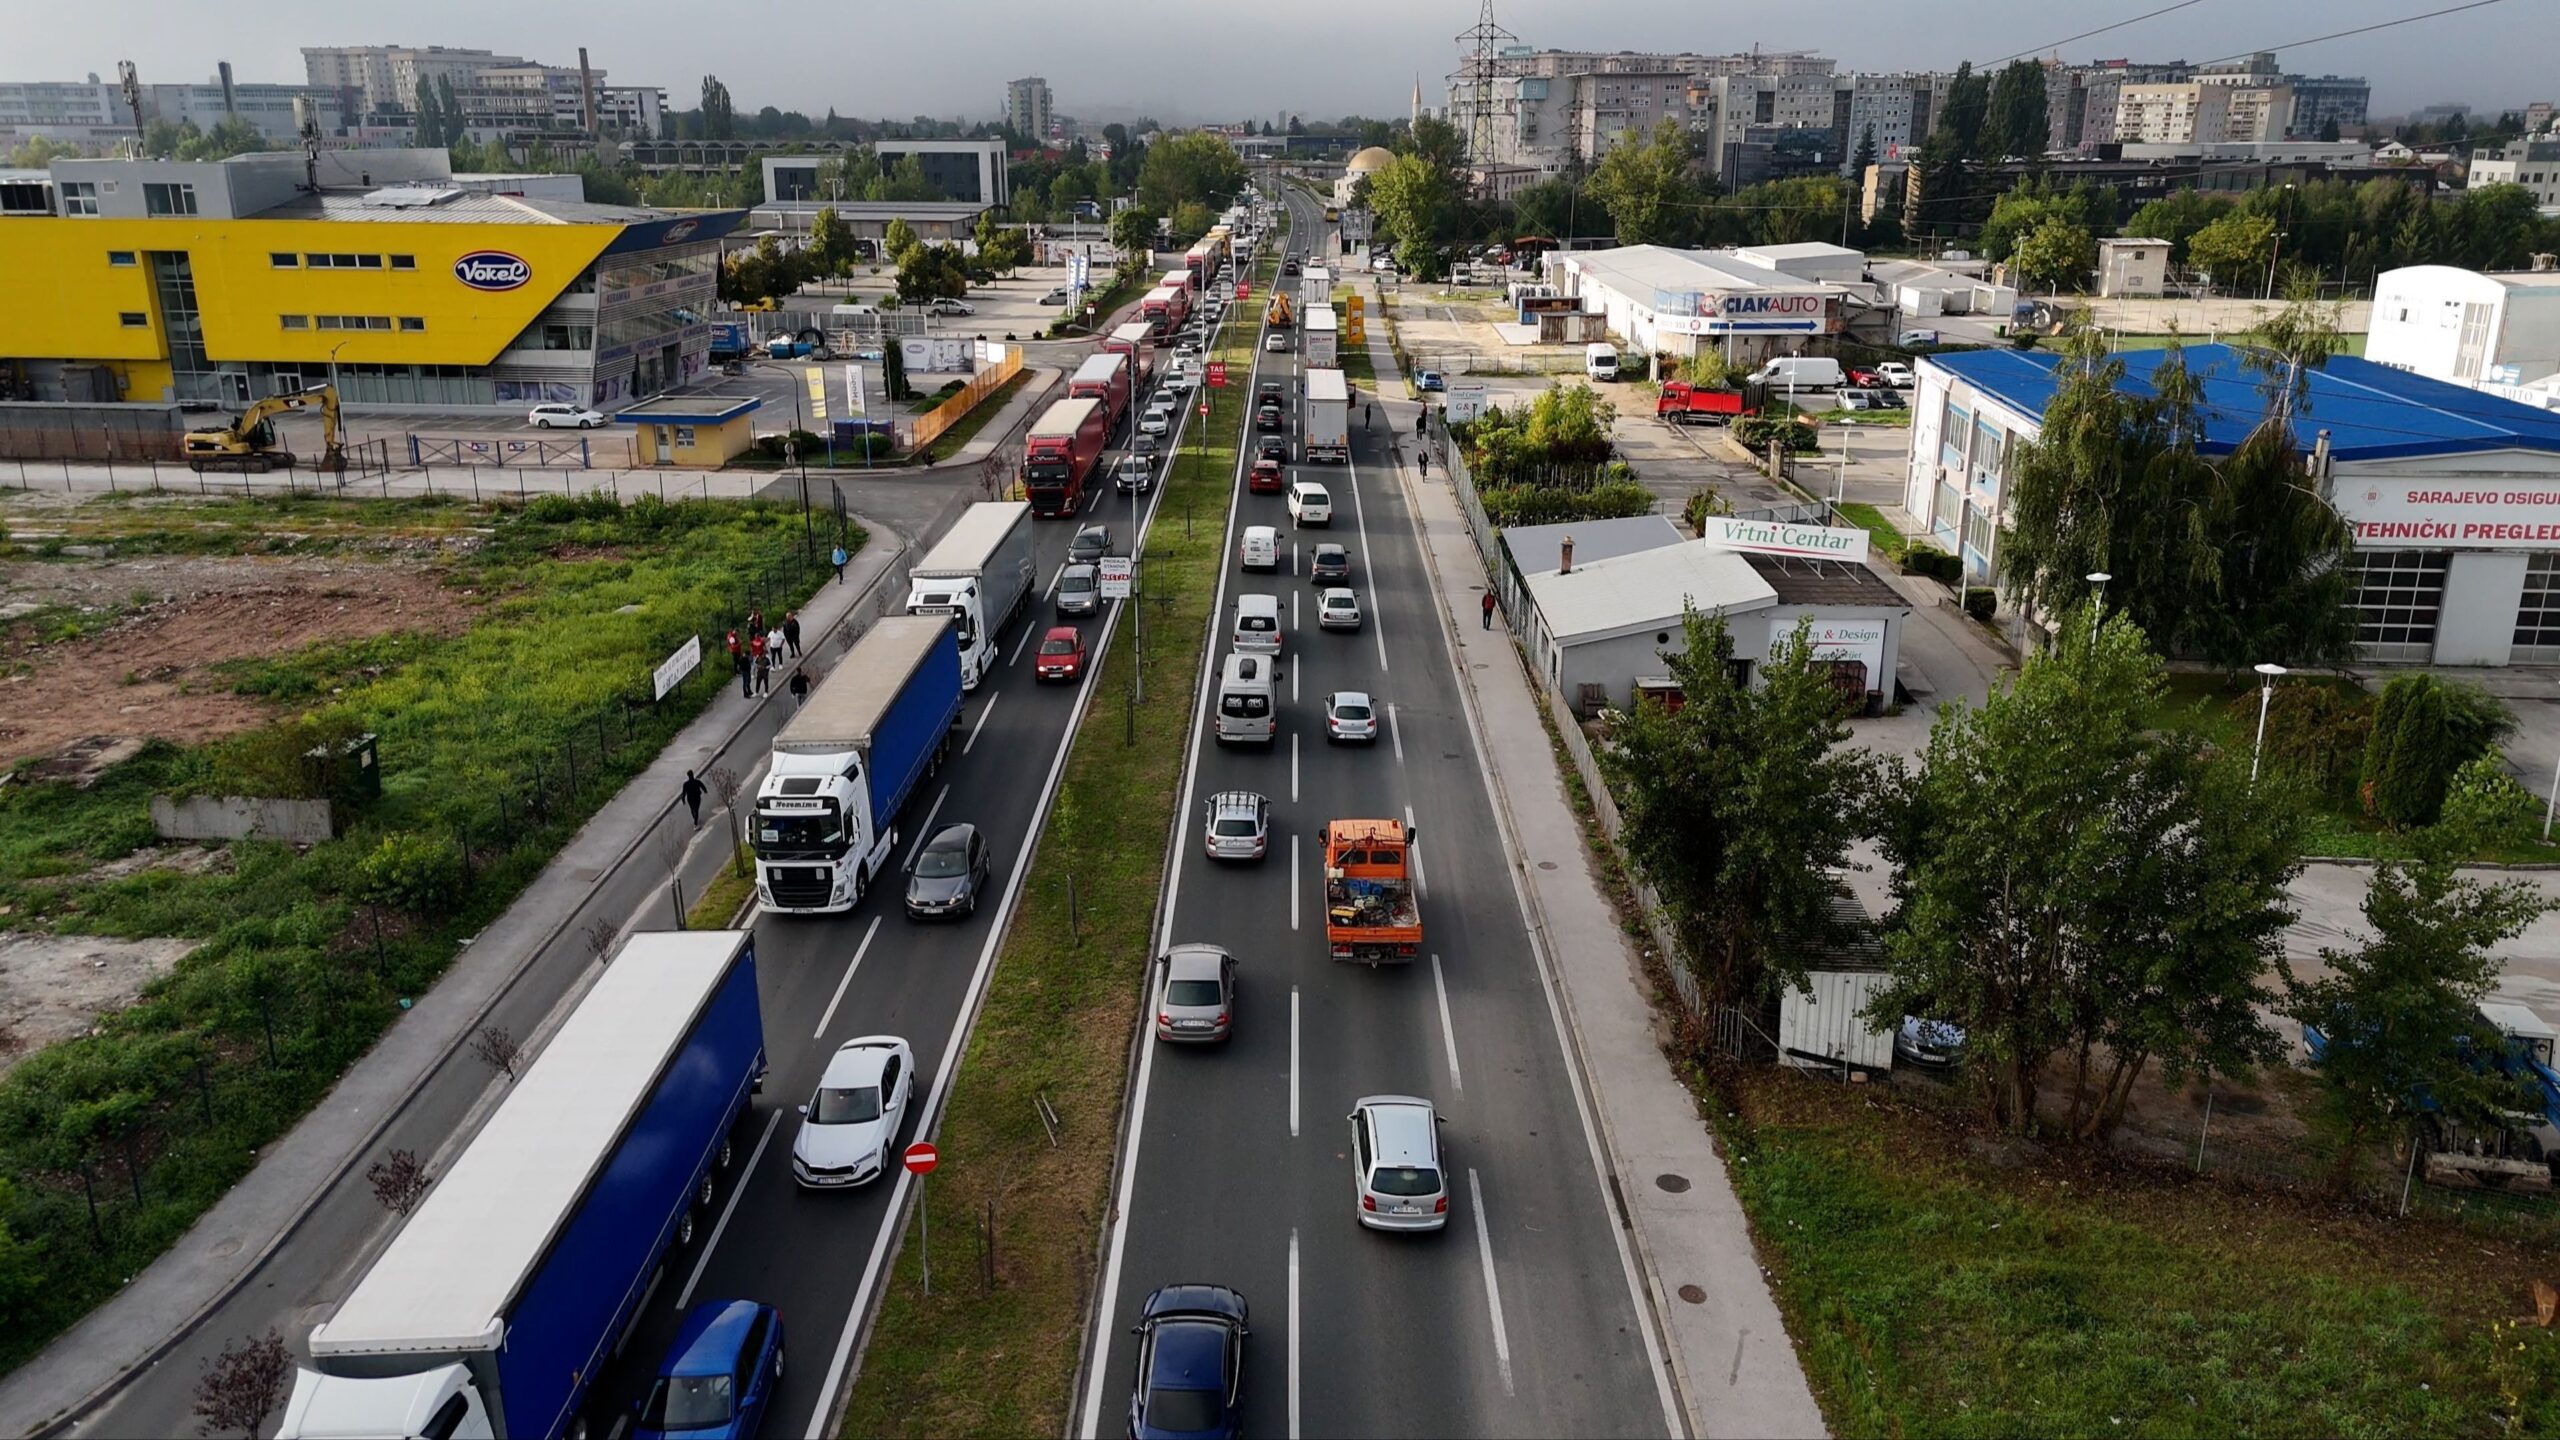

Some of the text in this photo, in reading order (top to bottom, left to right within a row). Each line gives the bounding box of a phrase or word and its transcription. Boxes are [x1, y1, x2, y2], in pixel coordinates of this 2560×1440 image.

[457, 260, 526, 281] Vokel
[1210, 365, 1224, 373] TAS
[2407, 491, 2560, 505] SARAJEVO OSIGU
[1723, 522, 1854, 550] Vrtni Centar
[2356, 517, 2457, 539] TEHNIČKI
[1777, 628, 1879, 642] Gaen & Design
